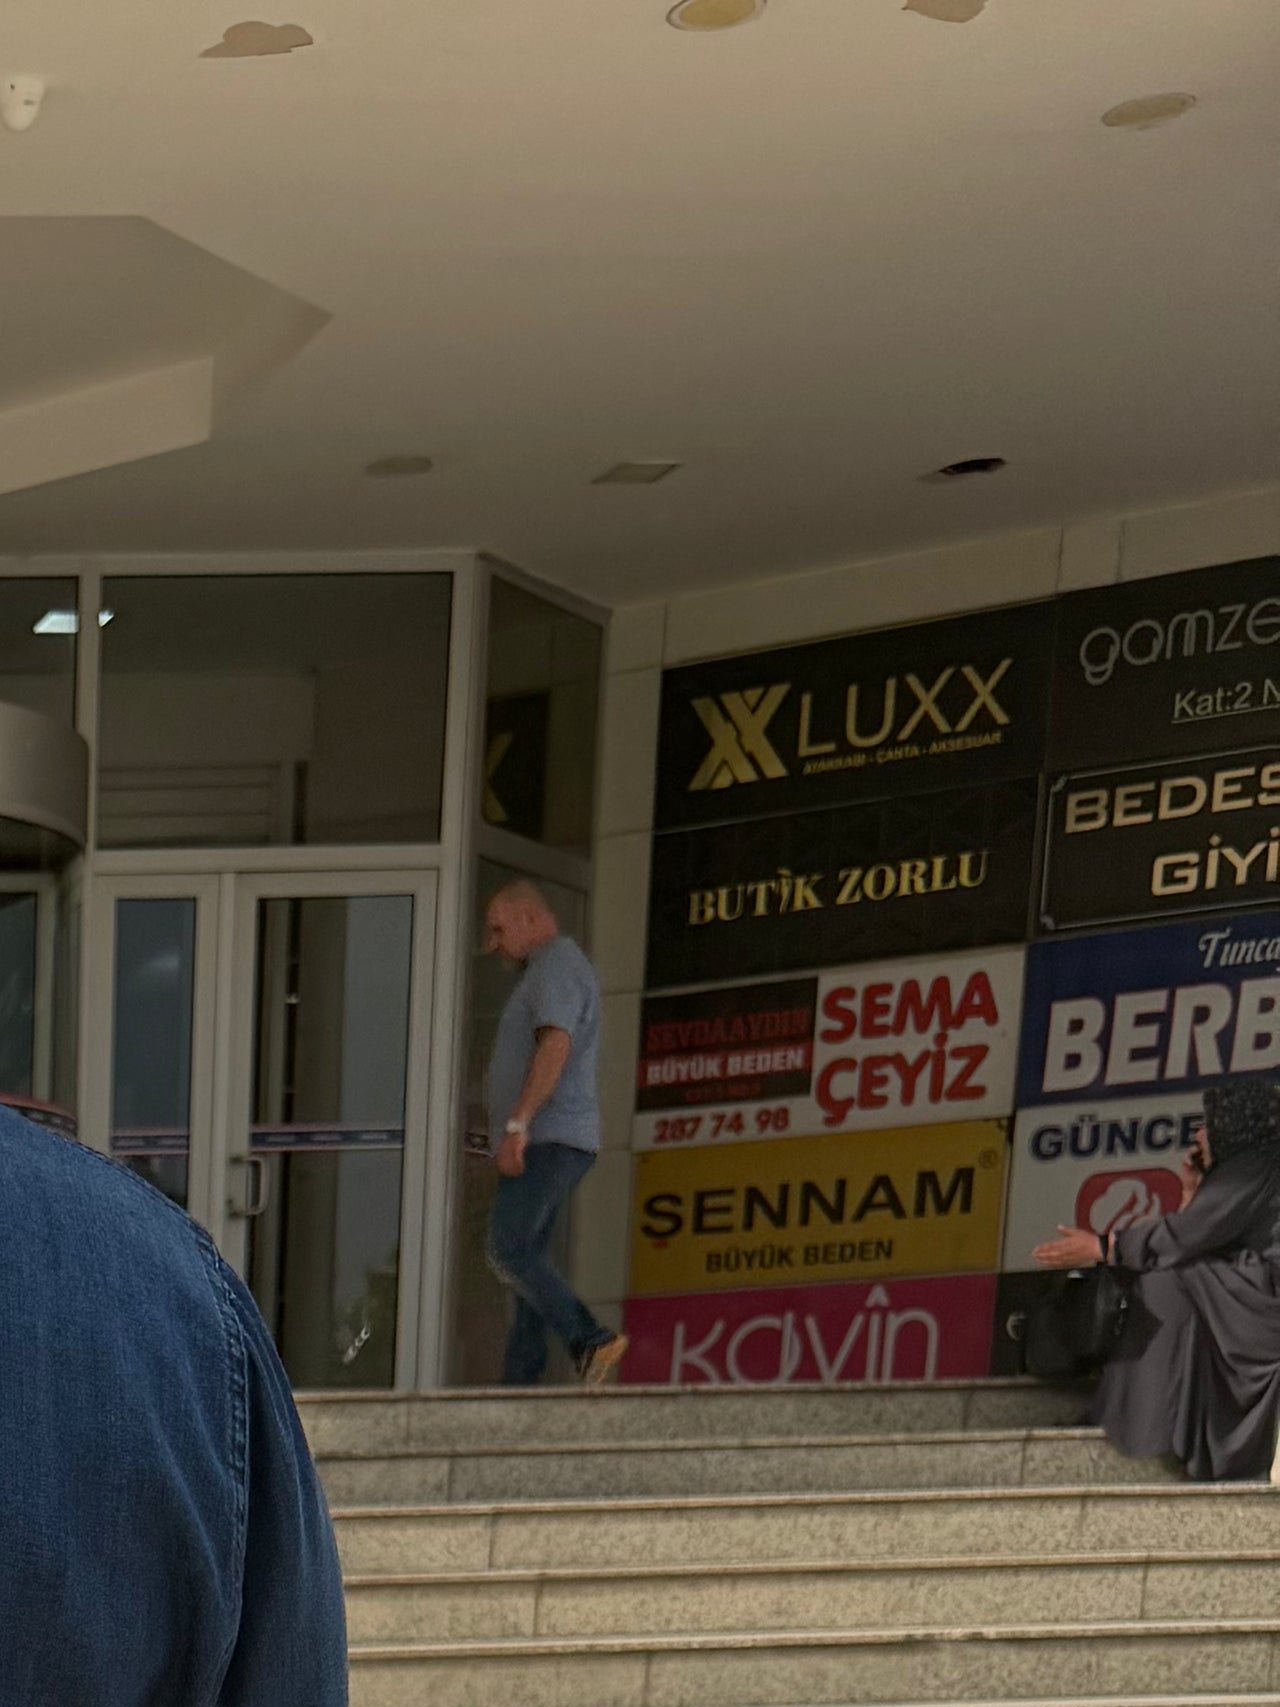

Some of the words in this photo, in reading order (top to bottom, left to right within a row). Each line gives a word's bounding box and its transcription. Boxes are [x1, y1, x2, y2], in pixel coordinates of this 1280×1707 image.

[1173, 681, 1253, 719] Kat:2
[836, 851, 990, 905] ZORLU
[821, 971, 999, 1045] SEMA
[646, 1054, 721, 1087] BÜYÜK
[726, 1047, 805, 1079] BEDEN
[815, 1032, 991, 1128] ÇEYİZ
[706, 1244, 793, 1274] BÜYÜK
[804, 1239, 893, 1265] BEDEN
